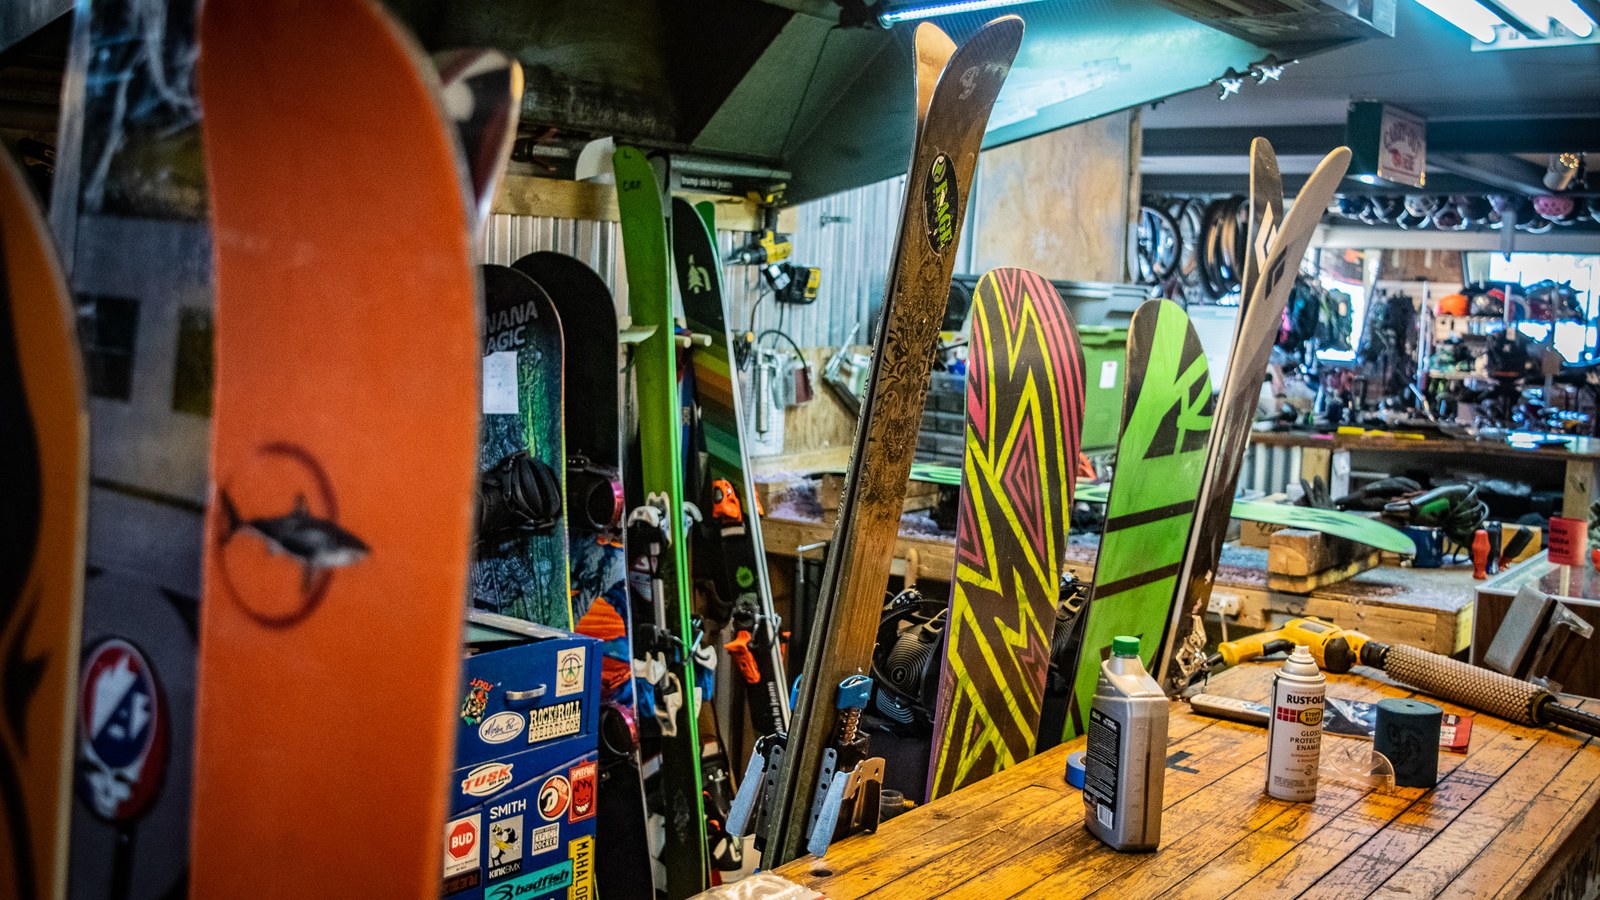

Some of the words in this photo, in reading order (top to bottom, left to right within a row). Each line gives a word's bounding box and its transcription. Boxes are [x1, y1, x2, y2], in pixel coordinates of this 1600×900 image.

[529, 706, 555, 727] ROCK
[557, 700, 581, 720] ROLL
[464, 766, 511, 791] TUSK
[489, 798, 527, 819] SMITH
[451, 832, 474, 849] BUD
[515, 869, 570, 896] badfish
